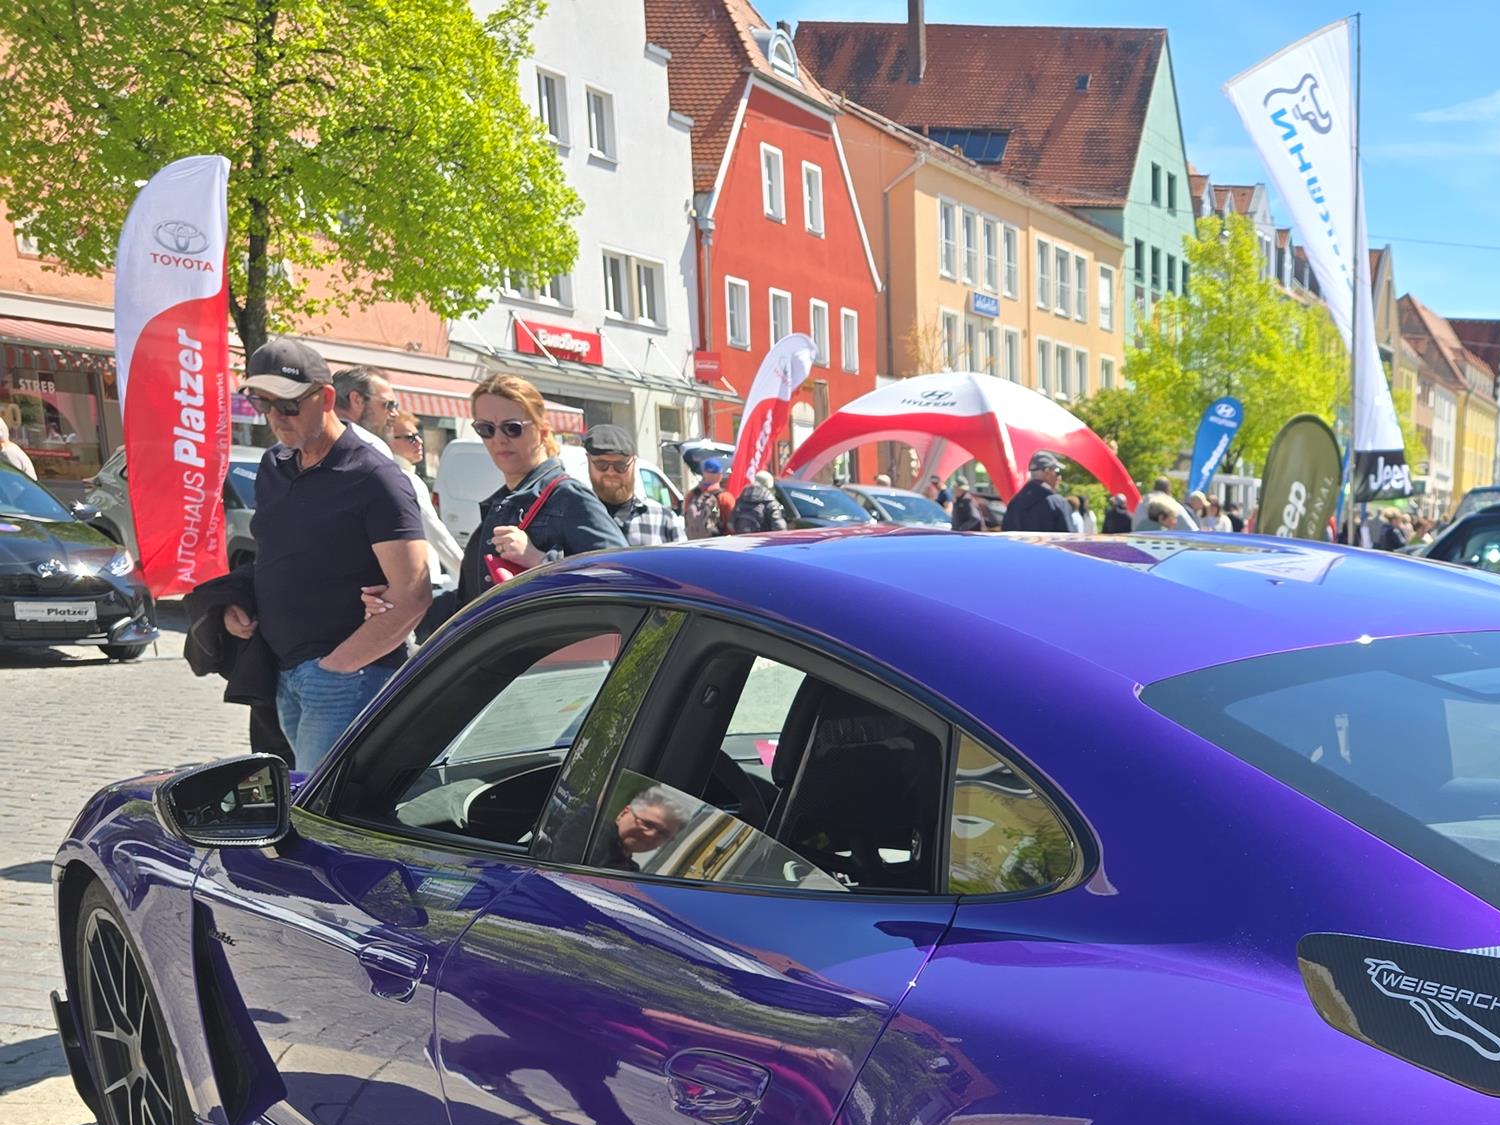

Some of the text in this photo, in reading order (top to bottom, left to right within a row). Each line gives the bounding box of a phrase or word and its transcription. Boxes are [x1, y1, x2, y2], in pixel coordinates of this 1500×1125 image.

[149, 252, 214, 273] TOYOTA
[215, 372, 226, 437] Neumarkt
[173, 327, 206, 583] AUTOHAUS Platzer
[215, 437, 228, 451] in
[1369, 456, 1413, 496] Jeep
[1275, 480, 1307, 538] eep
[1307, 475, 1335, 535] GINAL
[46, 607, 89, 616] Platzer
